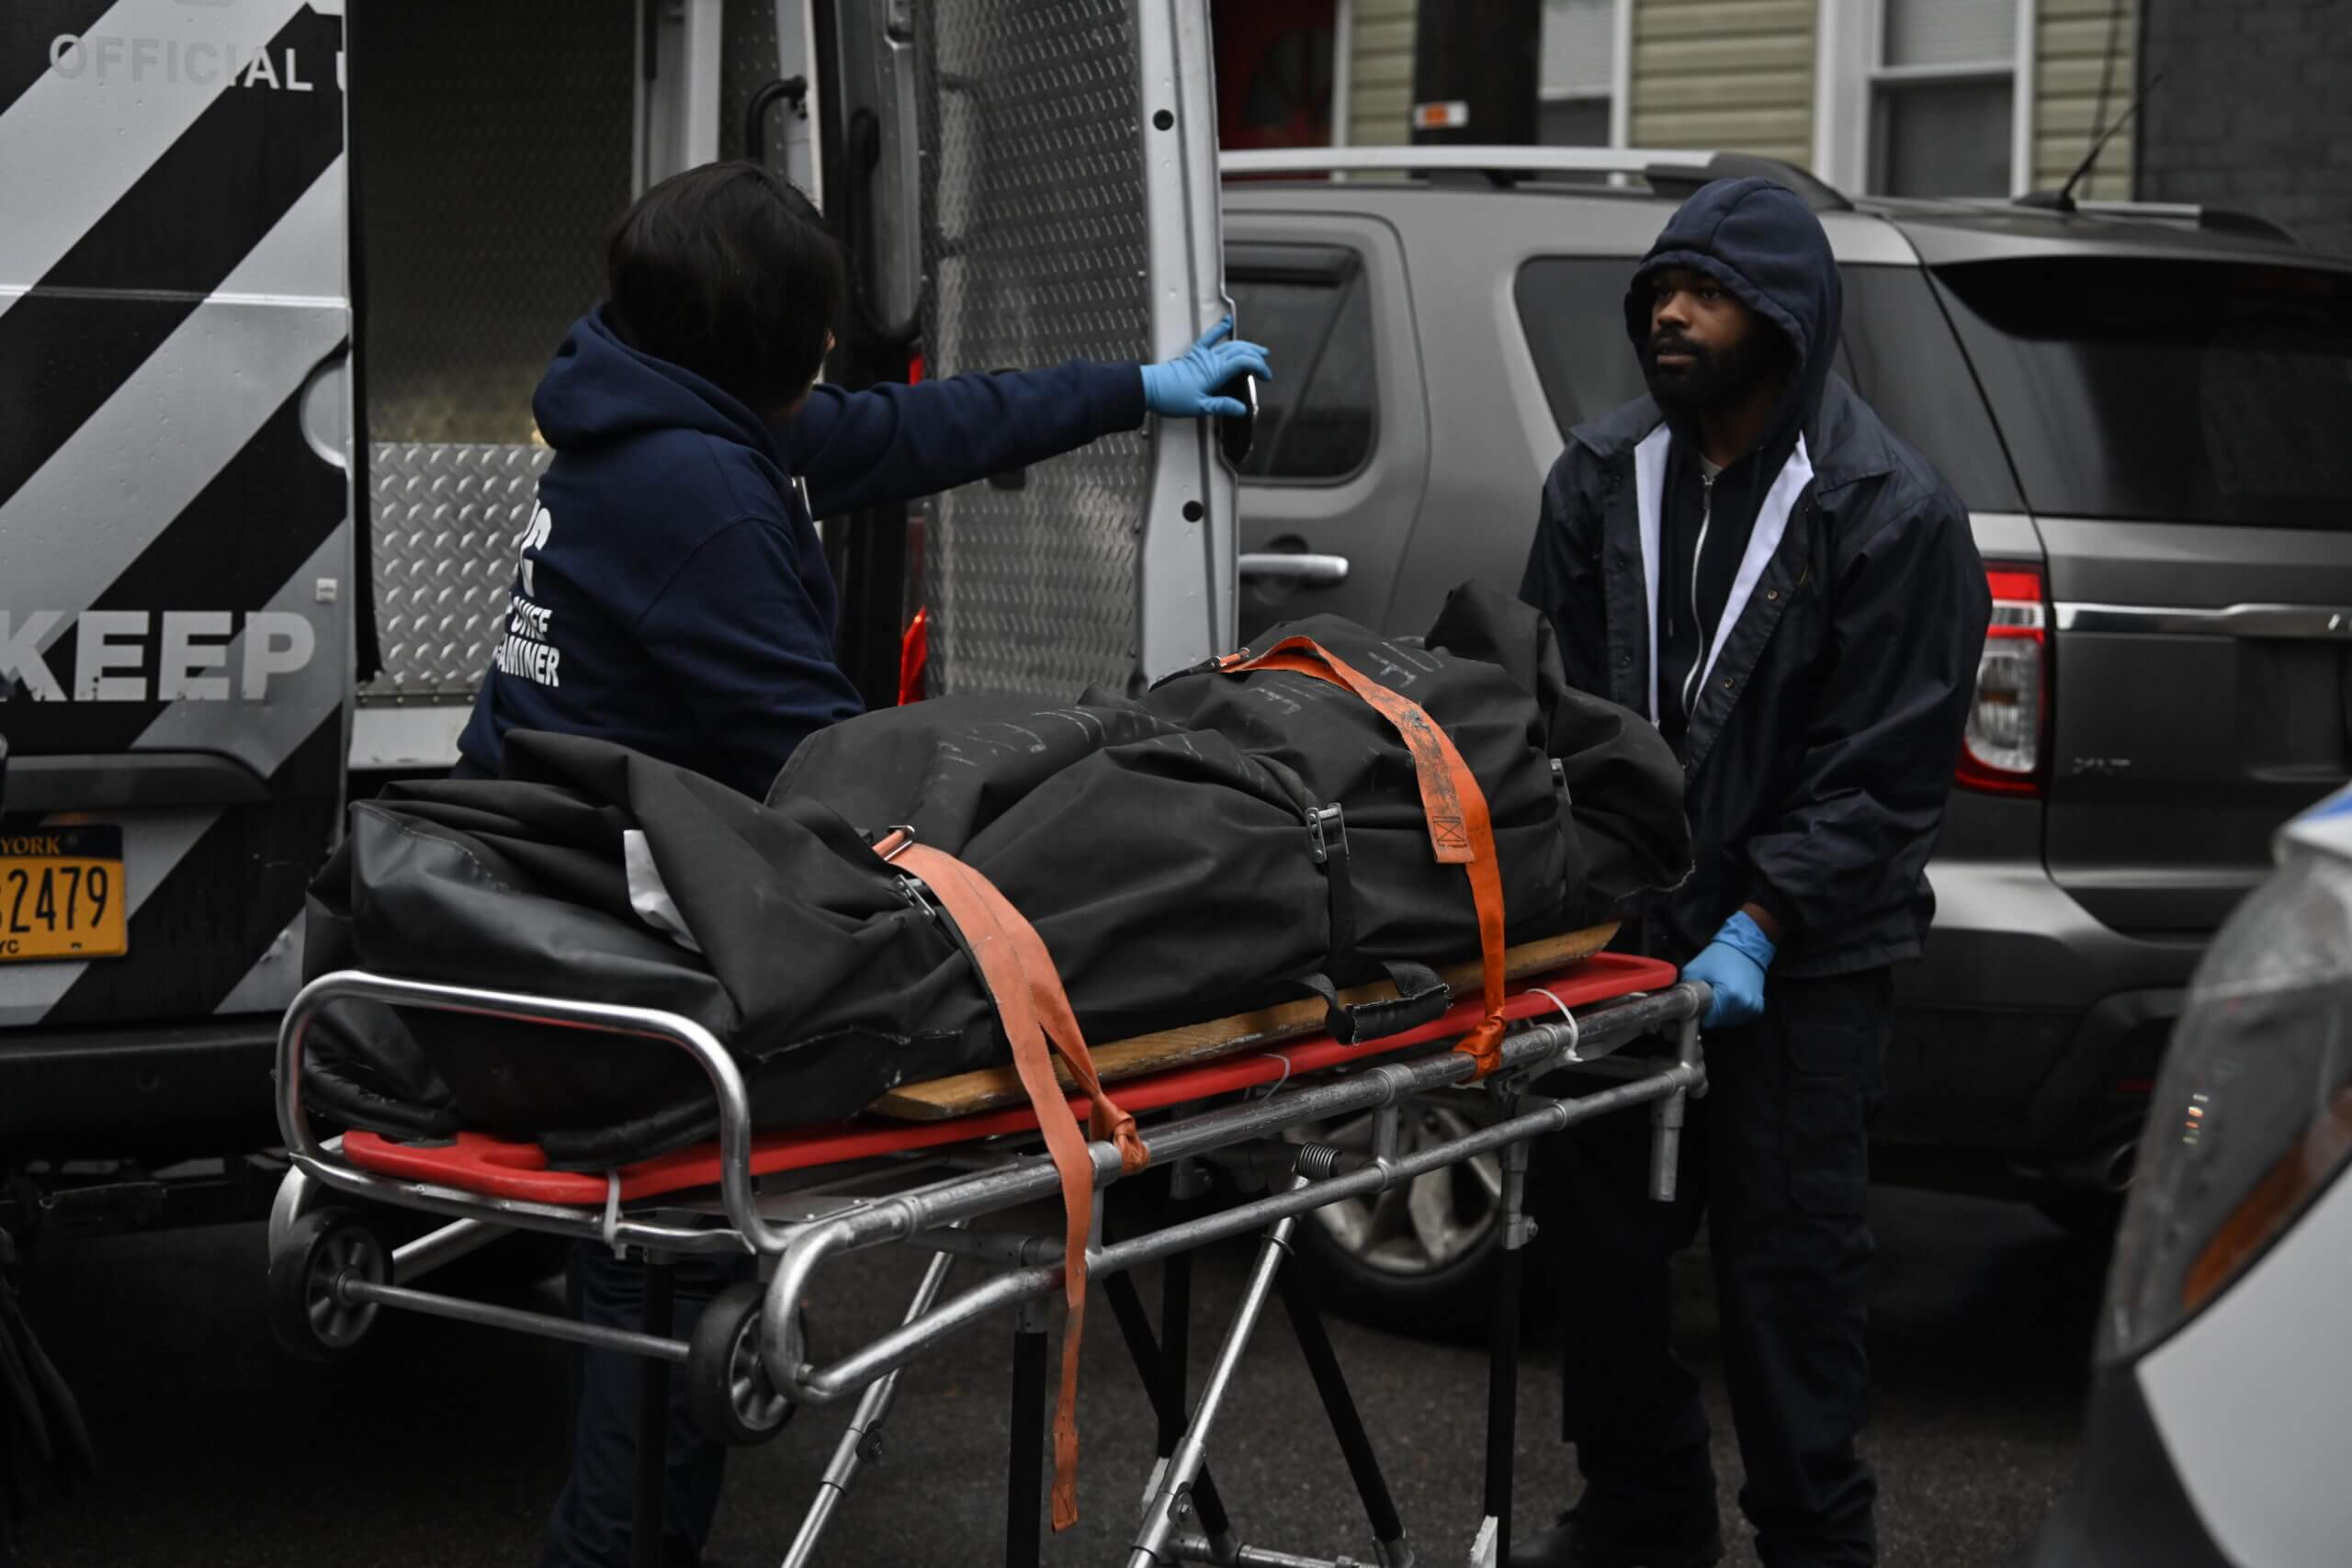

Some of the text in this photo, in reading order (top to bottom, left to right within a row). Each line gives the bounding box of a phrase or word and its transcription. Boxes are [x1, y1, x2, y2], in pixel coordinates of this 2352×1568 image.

[49, 32, 315, 93] OFFICIAL
[0, 610, 316, 703] KEEP
[0, 836, 61, 854] YORK
[0, 866, 108, 934] 2479
